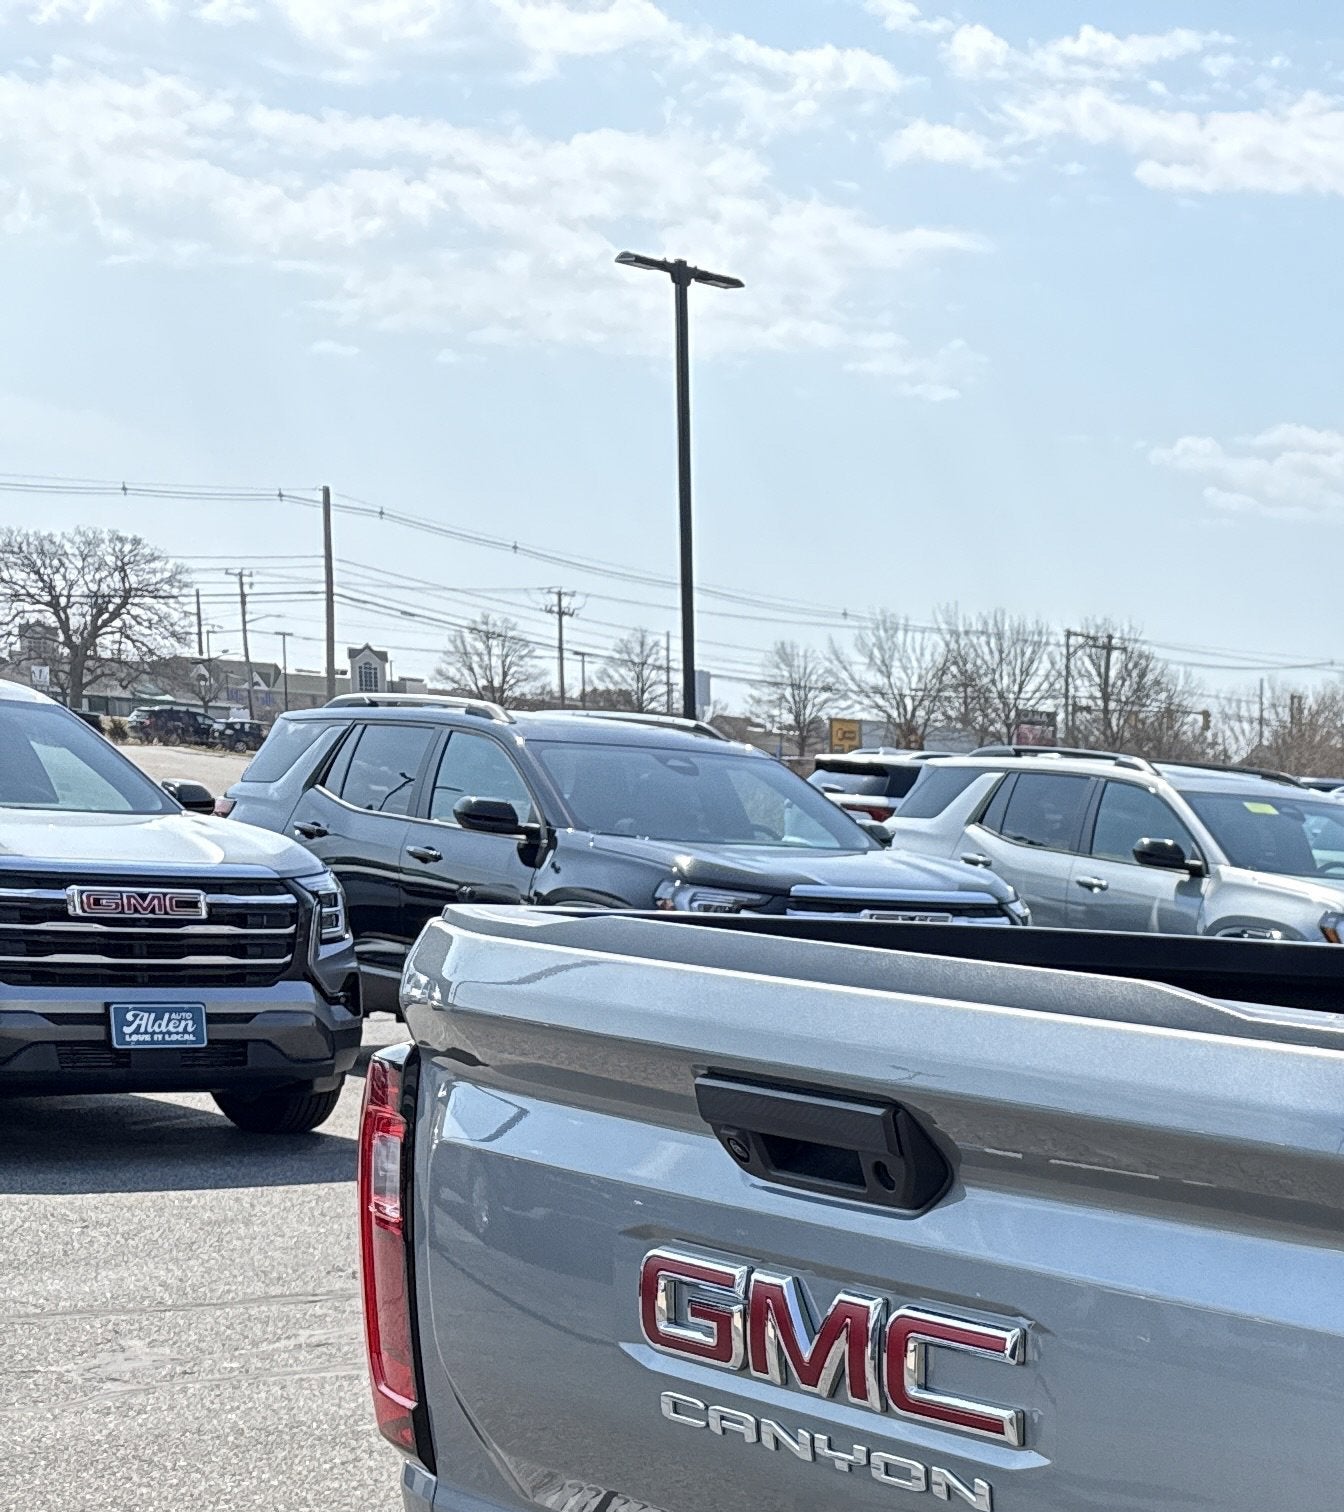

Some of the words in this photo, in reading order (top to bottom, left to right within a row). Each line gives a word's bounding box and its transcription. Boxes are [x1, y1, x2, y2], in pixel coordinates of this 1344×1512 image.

[82, 891, 202, 915] GMC
[122, 1010, 197, 1034] Alden
[171, 1012, 193, 1020] AUTO
[125, 1033, 151, 1041] LOVE
[154, 1033, 163, 1041] IT
[165, 1033, 196, 1041] LOCAL
[639, 1246, 1027, 1447] GMC
[660, 1391, 994, 1512] CANYON
